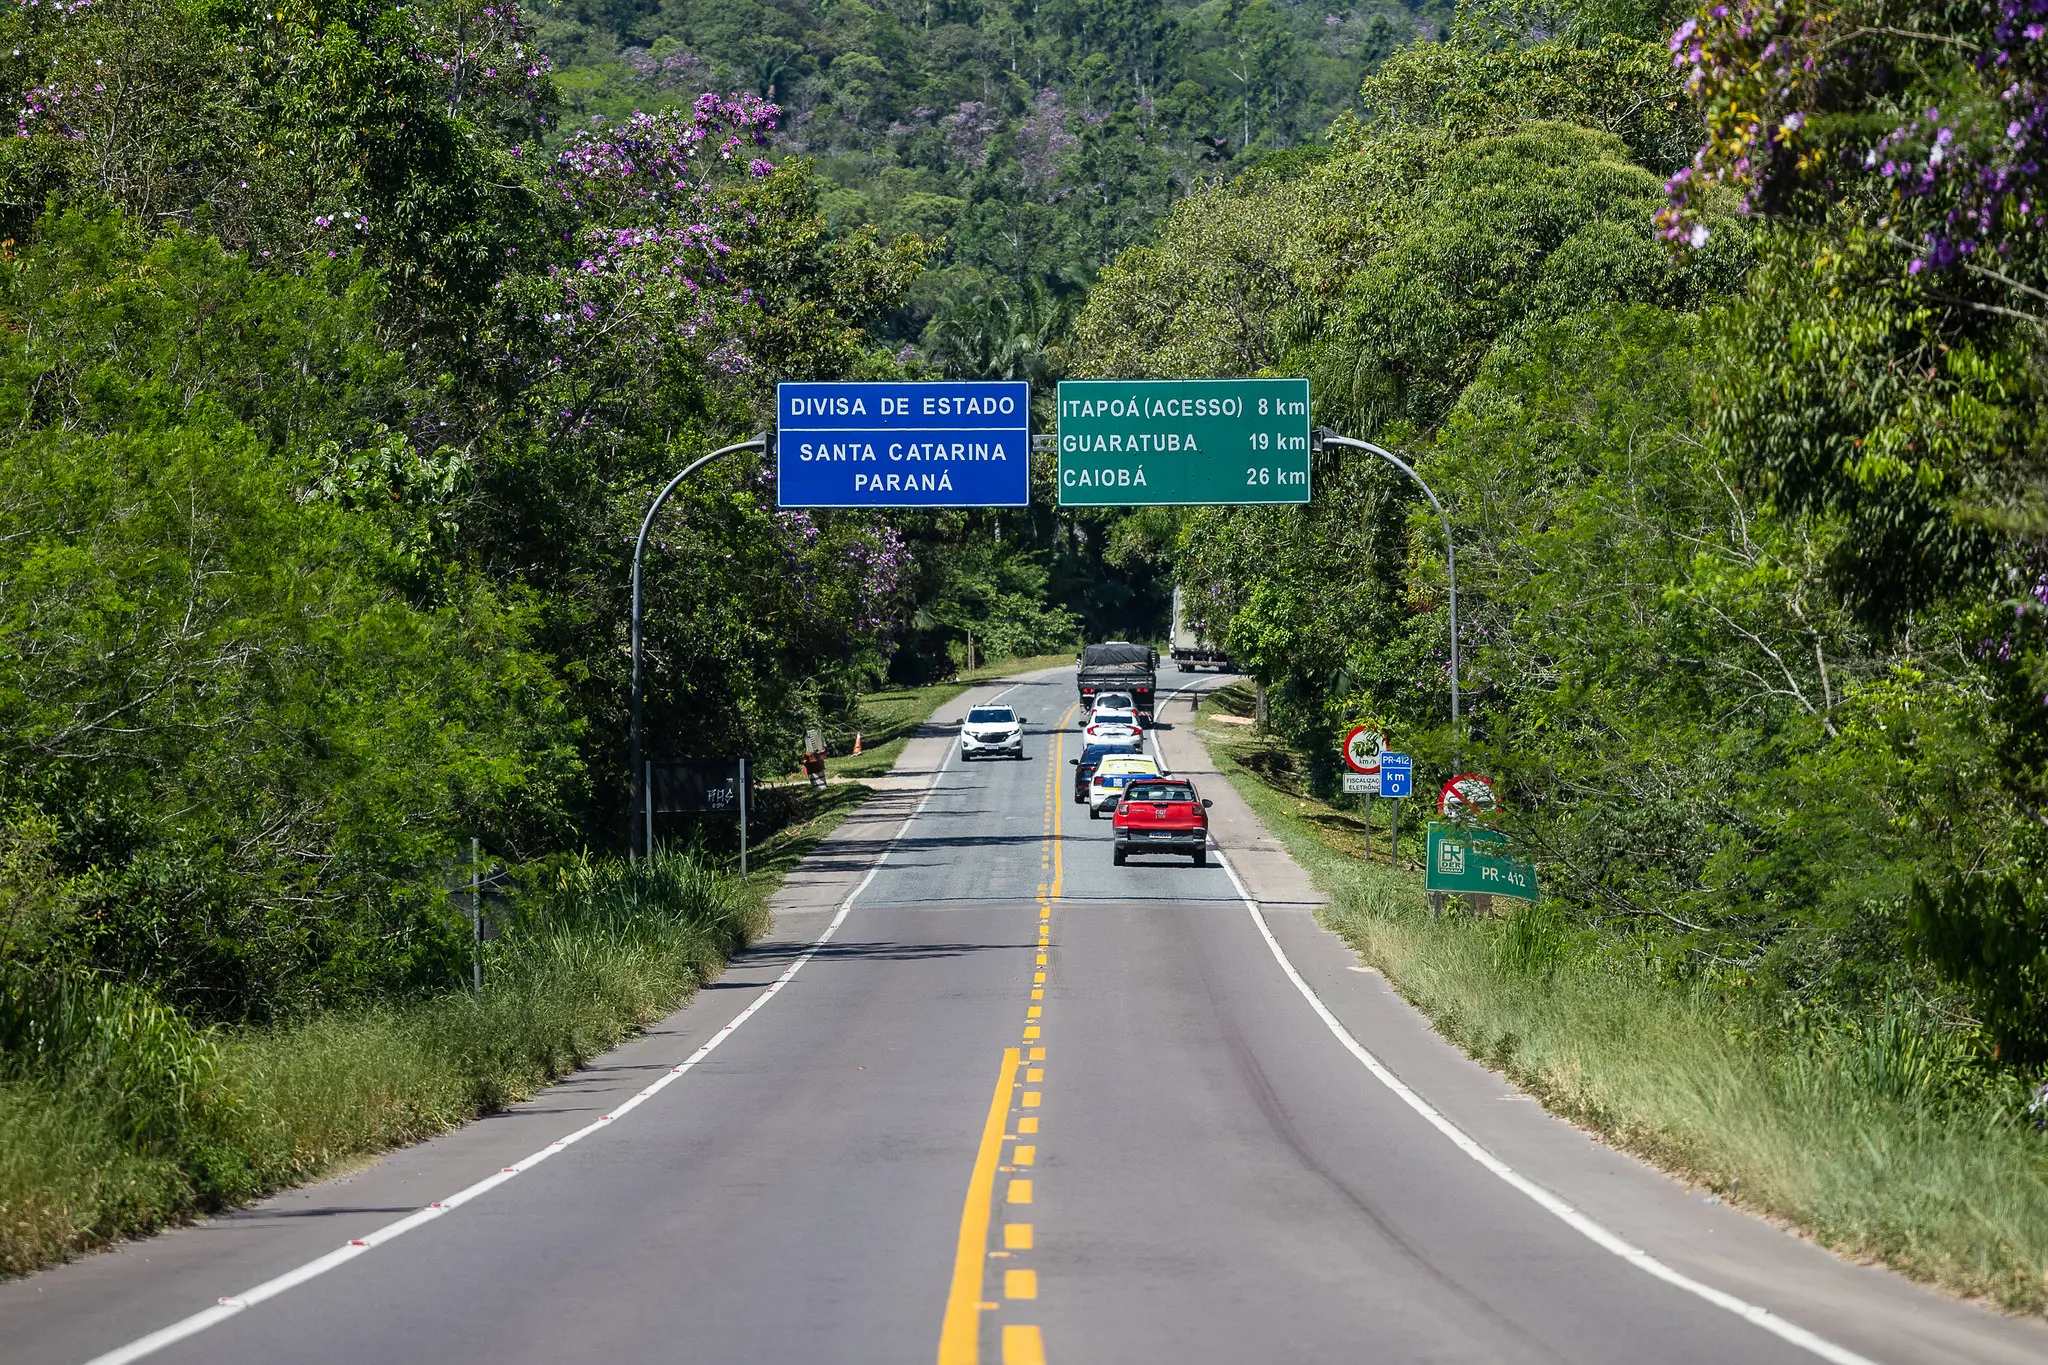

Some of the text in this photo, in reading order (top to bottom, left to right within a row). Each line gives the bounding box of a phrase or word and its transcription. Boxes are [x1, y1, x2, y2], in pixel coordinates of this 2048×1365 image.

[791, 396, 1015, 416] DIVISA DE ESTADO
[1257, 398, 1269, 416] 8
[1276, 398, 1305, 415] km
[1062, 432, 1305, 452] GUARATUBA 19 km
[799, 442, 1007, 462] SANTA CATARINA
[855, 469, 953, 491] PARANÁ
[1062, 464, 1306, 487] CAIOBÁ 26 km
[1382, 755, 1410, 765] PR-412
[1346, 777, 1380, 785] FISCALIZAÇ
[1387, 771, 1405, 781] km
[1348, 783, 1380, 791] ELETRÔNIC
[1391, 783, 1400, 793] 0
[1441, 861, 1461, 869] DER
